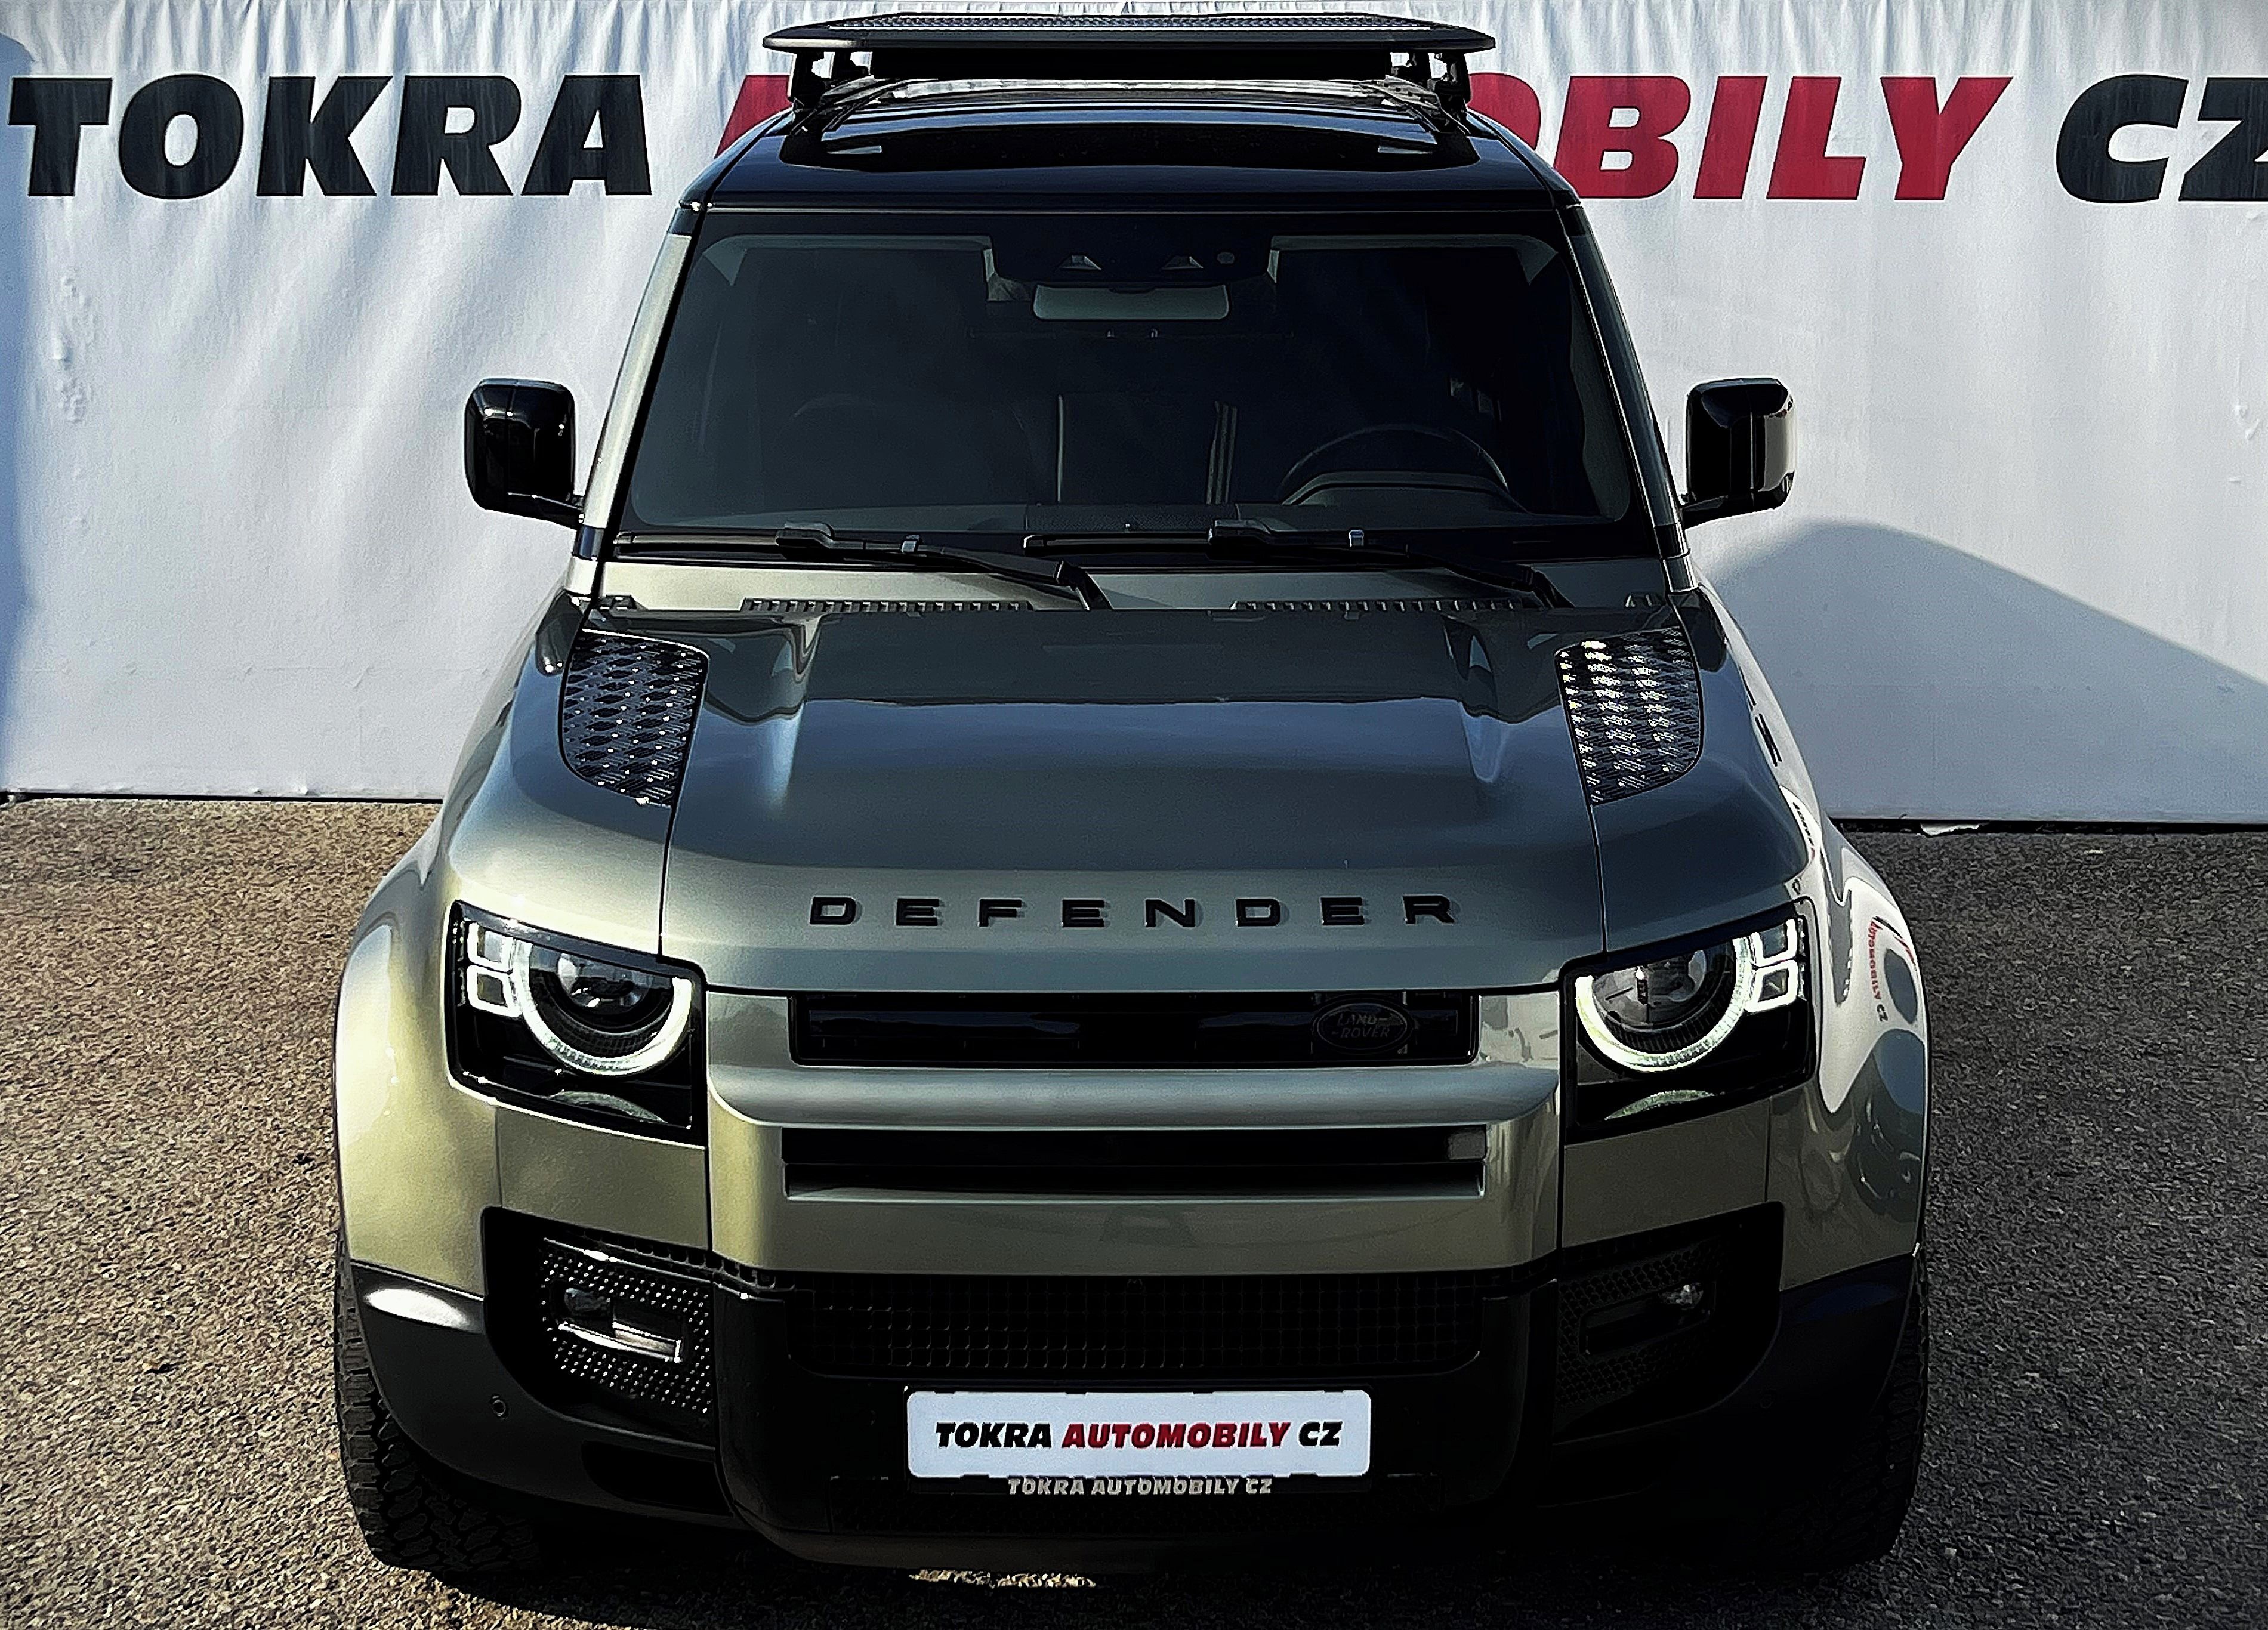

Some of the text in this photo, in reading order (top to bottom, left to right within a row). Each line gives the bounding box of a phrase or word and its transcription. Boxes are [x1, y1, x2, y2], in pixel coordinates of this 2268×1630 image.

[8, 73, 652, 199] TOKRA
[2055, 74, 2268, 203] CZ
[809, 895, 1455, 927] DEFENDER
[1337, 1013, 1377, 1026] LAND
[1340, 1027, 1390, 1038] ROVER
[936, 1421, 1343, 1449] TOKRA AUTOMOBILY CZ
[1008, 1478, 1273, 1495] TOKRA AUTOMOBILY CZ
